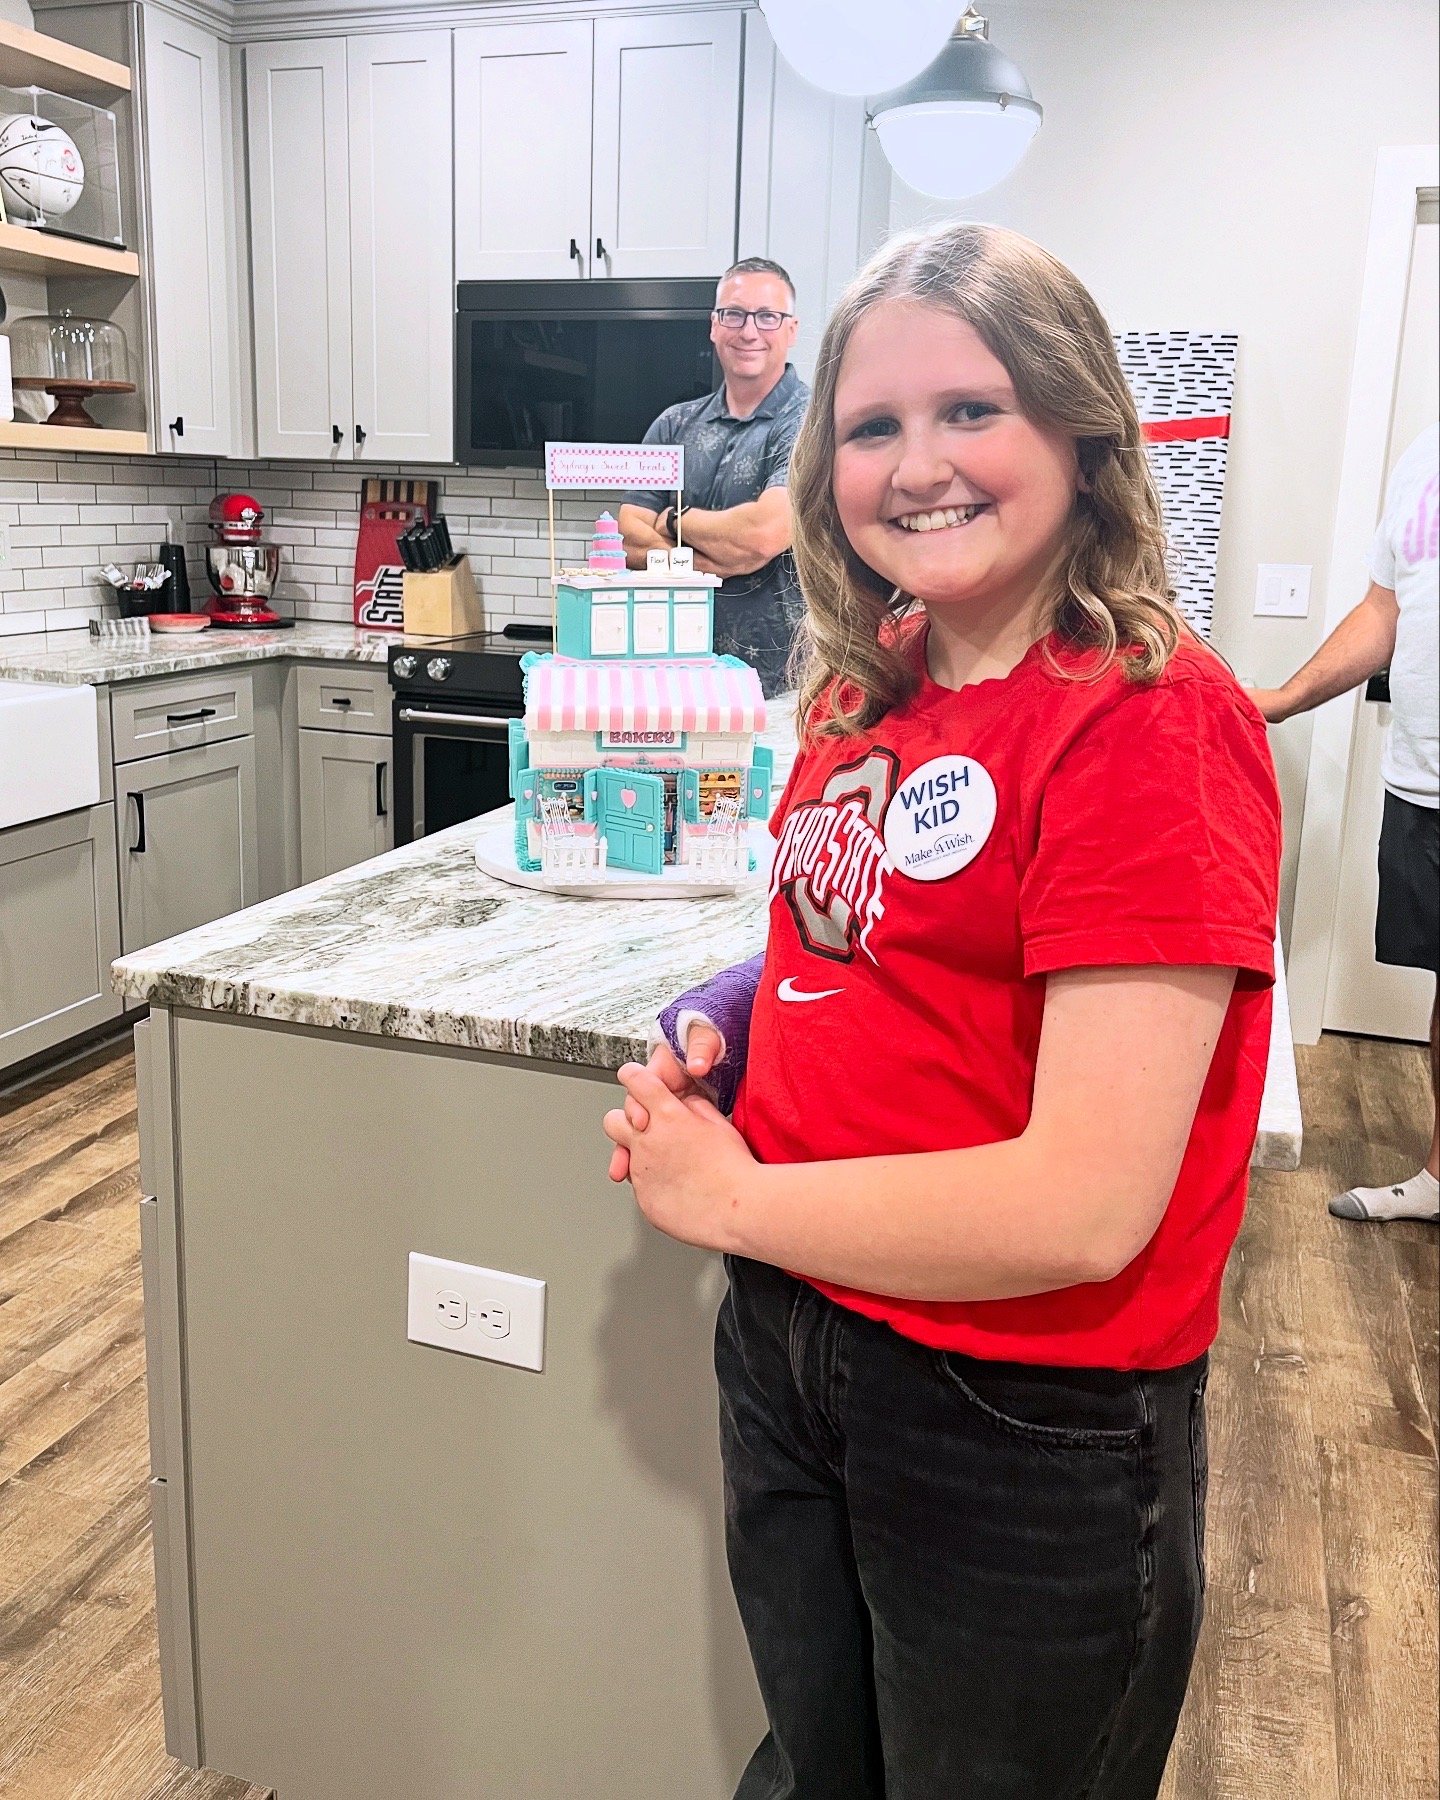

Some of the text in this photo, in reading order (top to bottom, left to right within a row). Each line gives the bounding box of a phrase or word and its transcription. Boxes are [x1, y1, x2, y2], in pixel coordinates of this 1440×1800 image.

[601, 460, 628, 471] Sweet
[638, 460, 666, 472] Treats
[672, 557, 690, 567] Sugar
[609, 731, 675, 744] BAKERY
[900, 765, 969, 810] WISH
[914, 799, 960, 834] KID
[904, 849, 933, 867] Make
[945, 833, 974, 851] Wish
